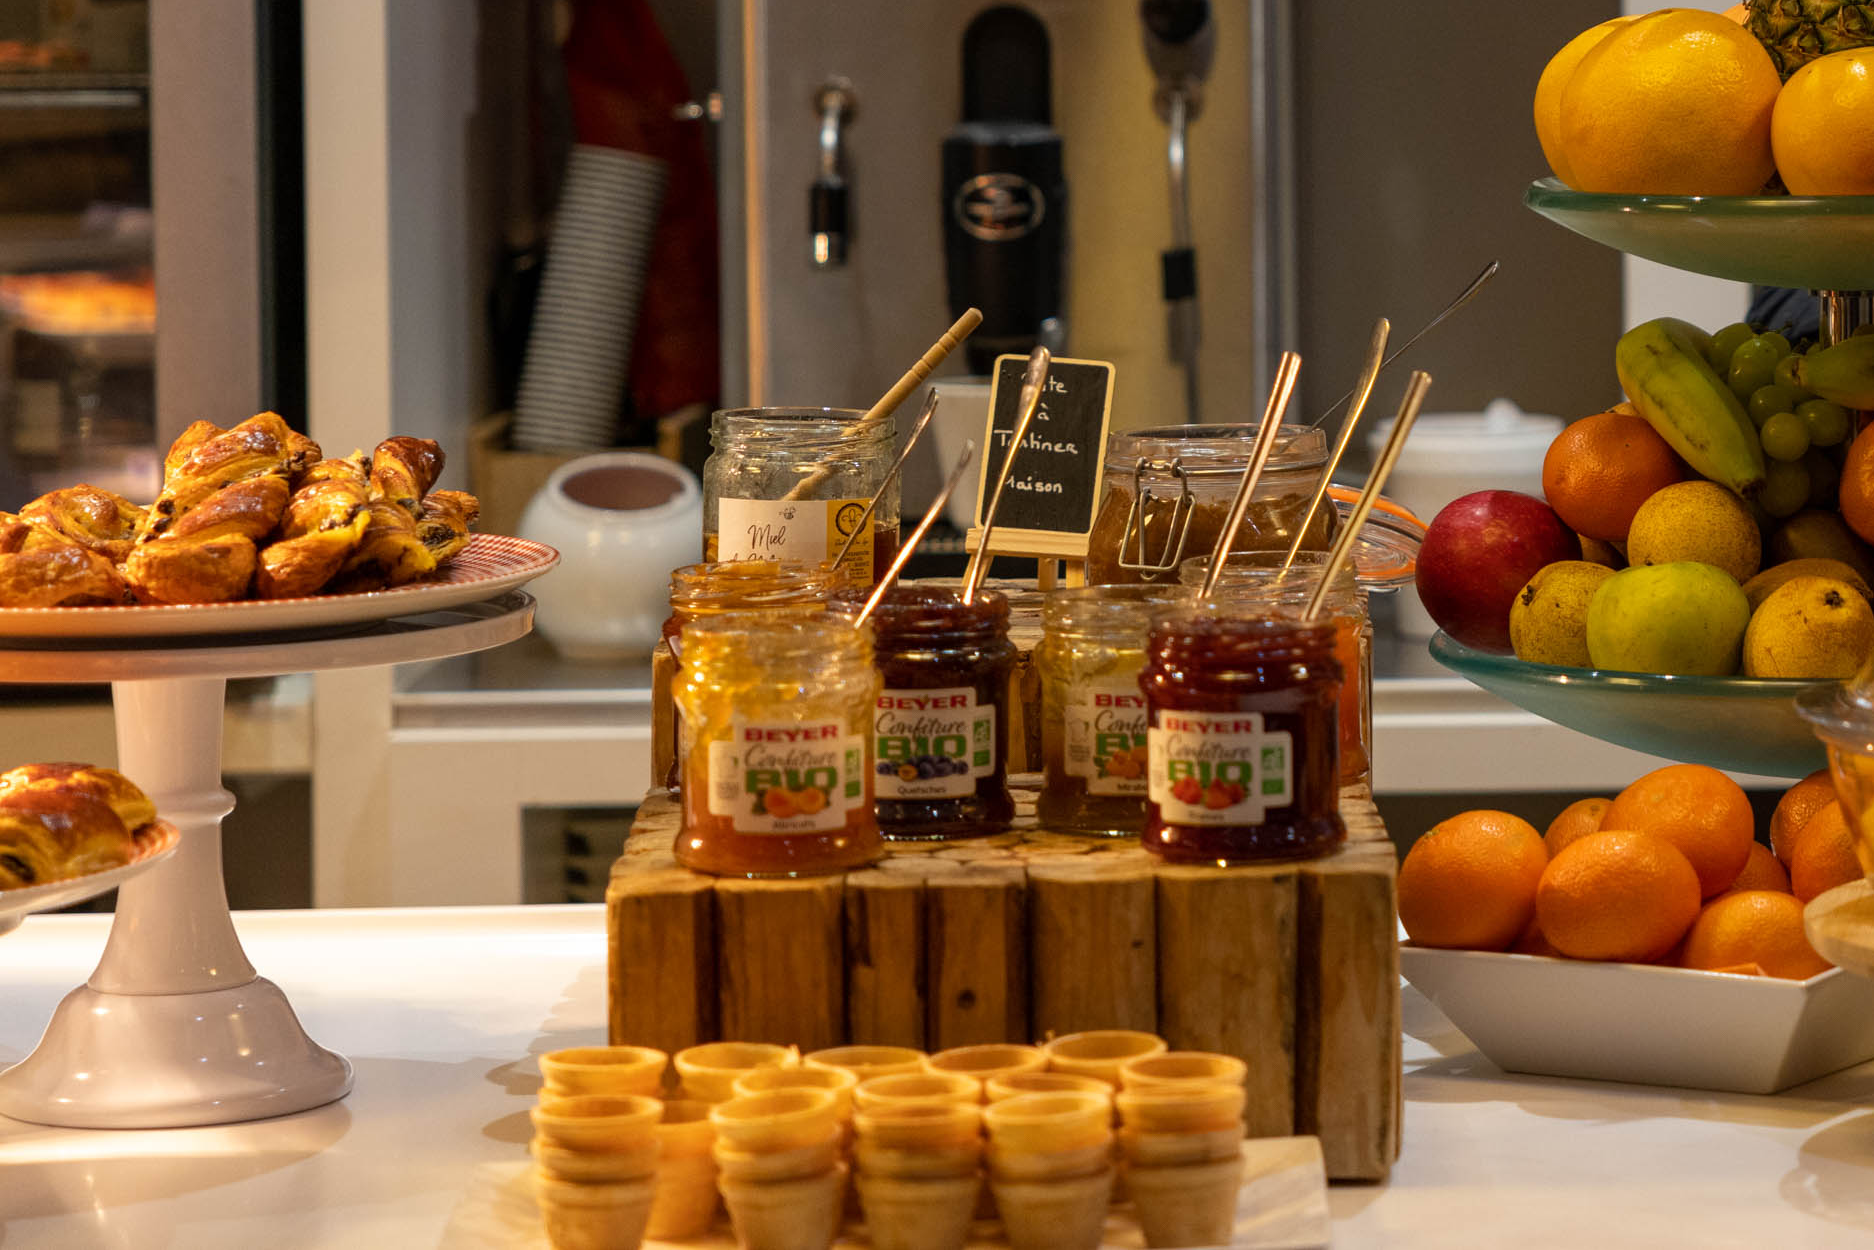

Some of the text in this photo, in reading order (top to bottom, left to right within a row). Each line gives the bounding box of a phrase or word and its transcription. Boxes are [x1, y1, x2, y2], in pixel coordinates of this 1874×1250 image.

[746, 523, 787, 551] Miel
[878, 694, 968, 711] BEYER
[744, 725, 839, 743] BEYER
[875, 711, 966, 744] Confiture
[1166, 717, 1252, 734] BEYER
[877, 734, 967, 762] BIO
[746, 766, 838, 794] BIO
[1168, 760, 1253, 788] BIO
